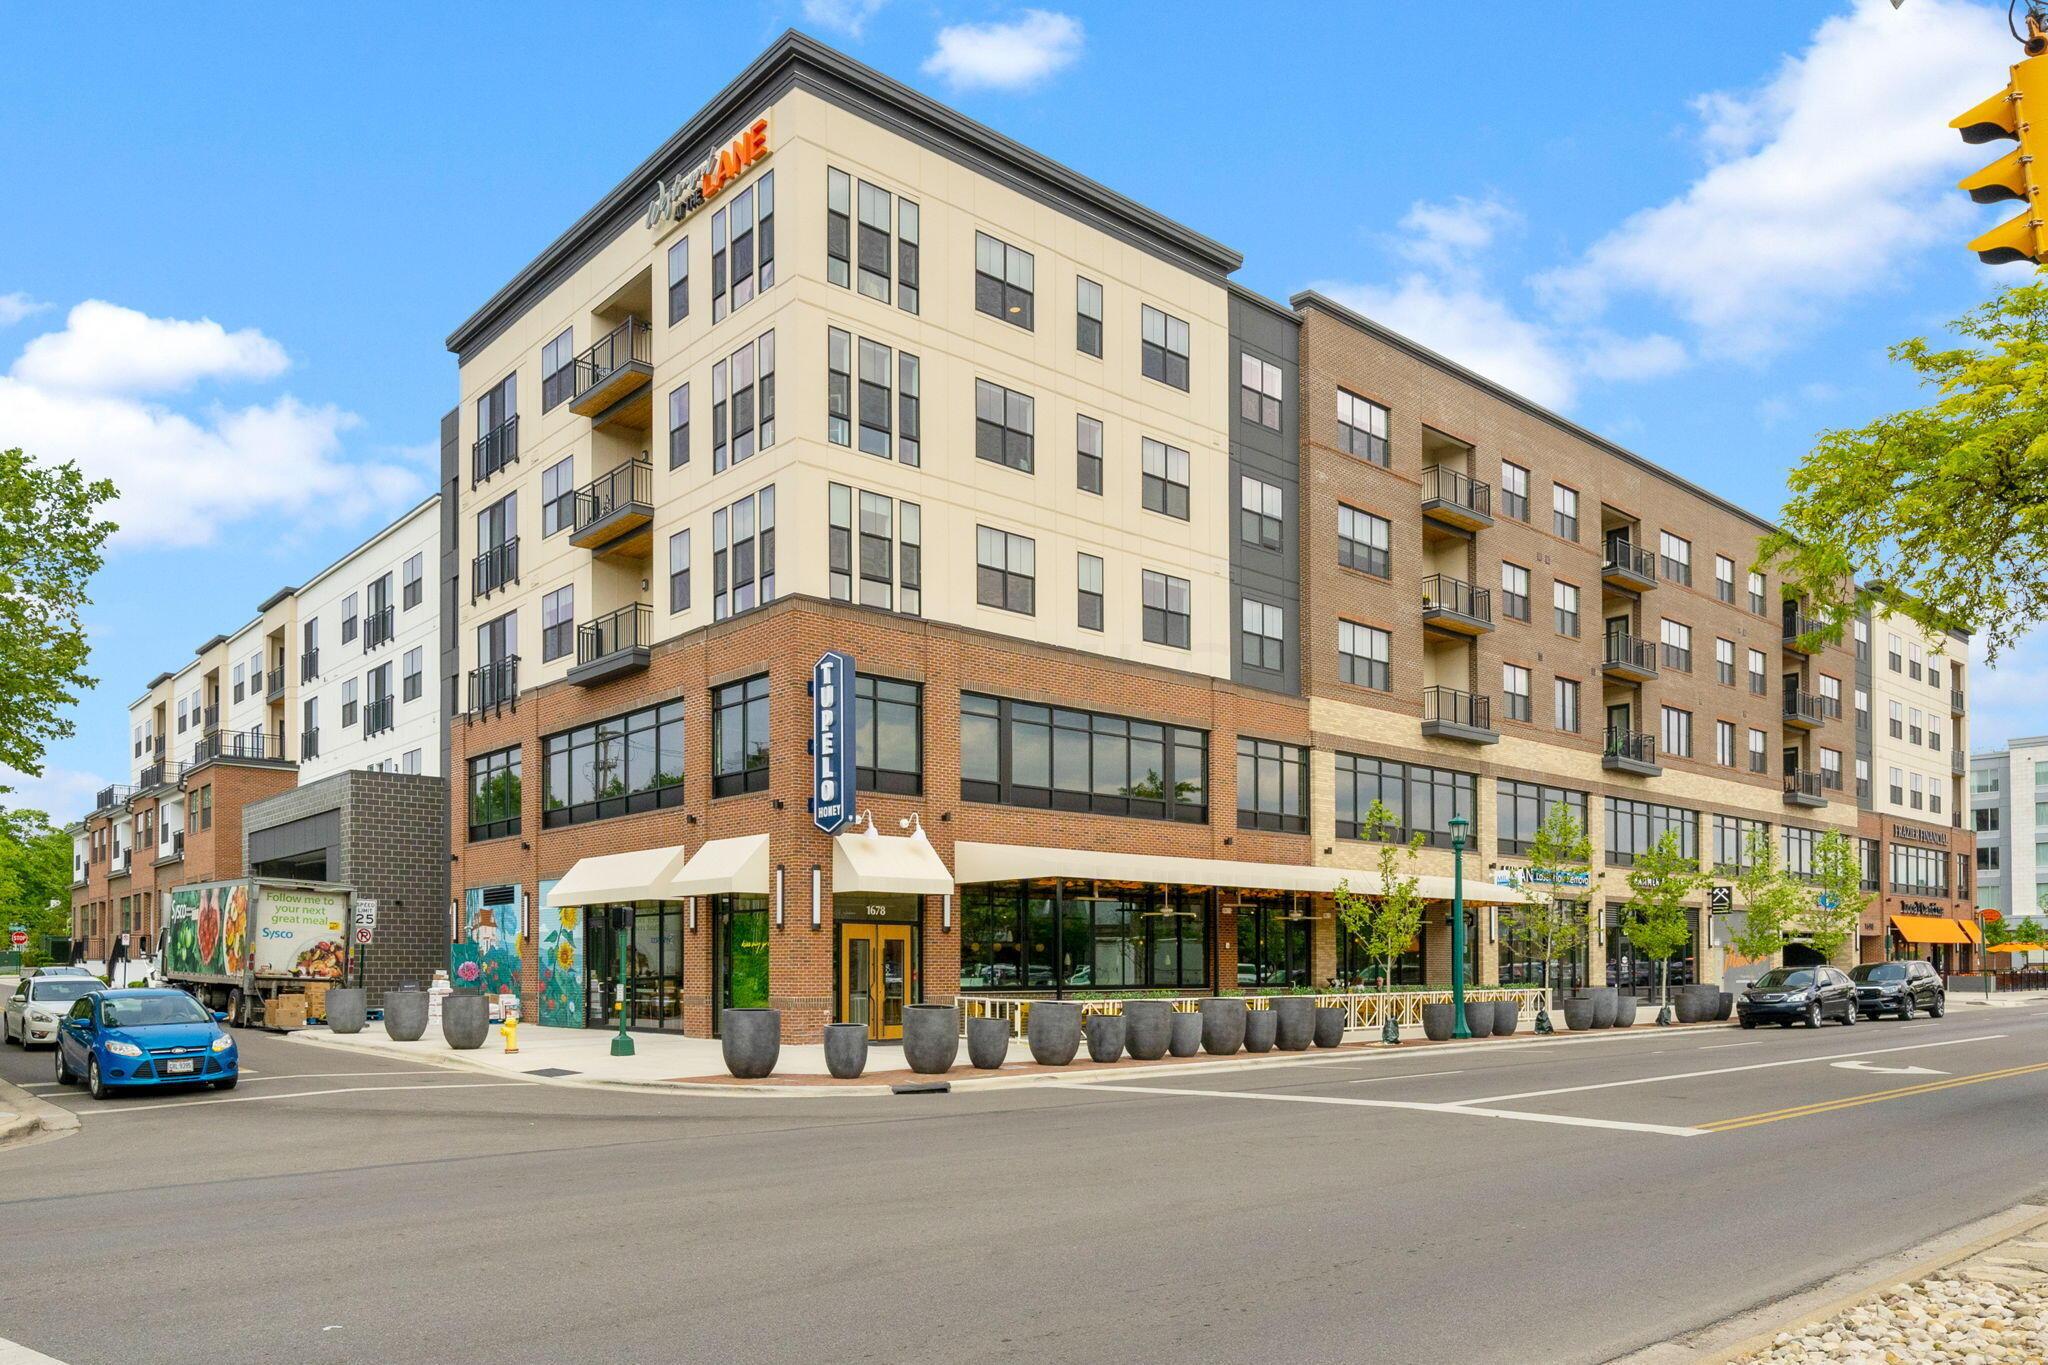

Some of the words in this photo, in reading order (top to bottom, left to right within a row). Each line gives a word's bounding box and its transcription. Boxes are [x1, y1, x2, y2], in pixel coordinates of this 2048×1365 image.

[703, 118, 768, 199] LANE
[820, 661, 835, 802] TUPELO
[818, 803, 841, 819] HONEY
[266, 893, 301, 904] Follow
[303, 896, 321, 905] me
[323, 897, 335, 906] to
[171, 900, 187, 924] Sysco
[274, 904, 299, 915] your
[303, 905, 326, 915] next
[866, 905, 886, 916] 1678
[271, 914, 299, 925] great
[303, 917, 328, 926] meal
[355, 913, 374, 924] 25
[262, 927, 294, 940] Sysco
